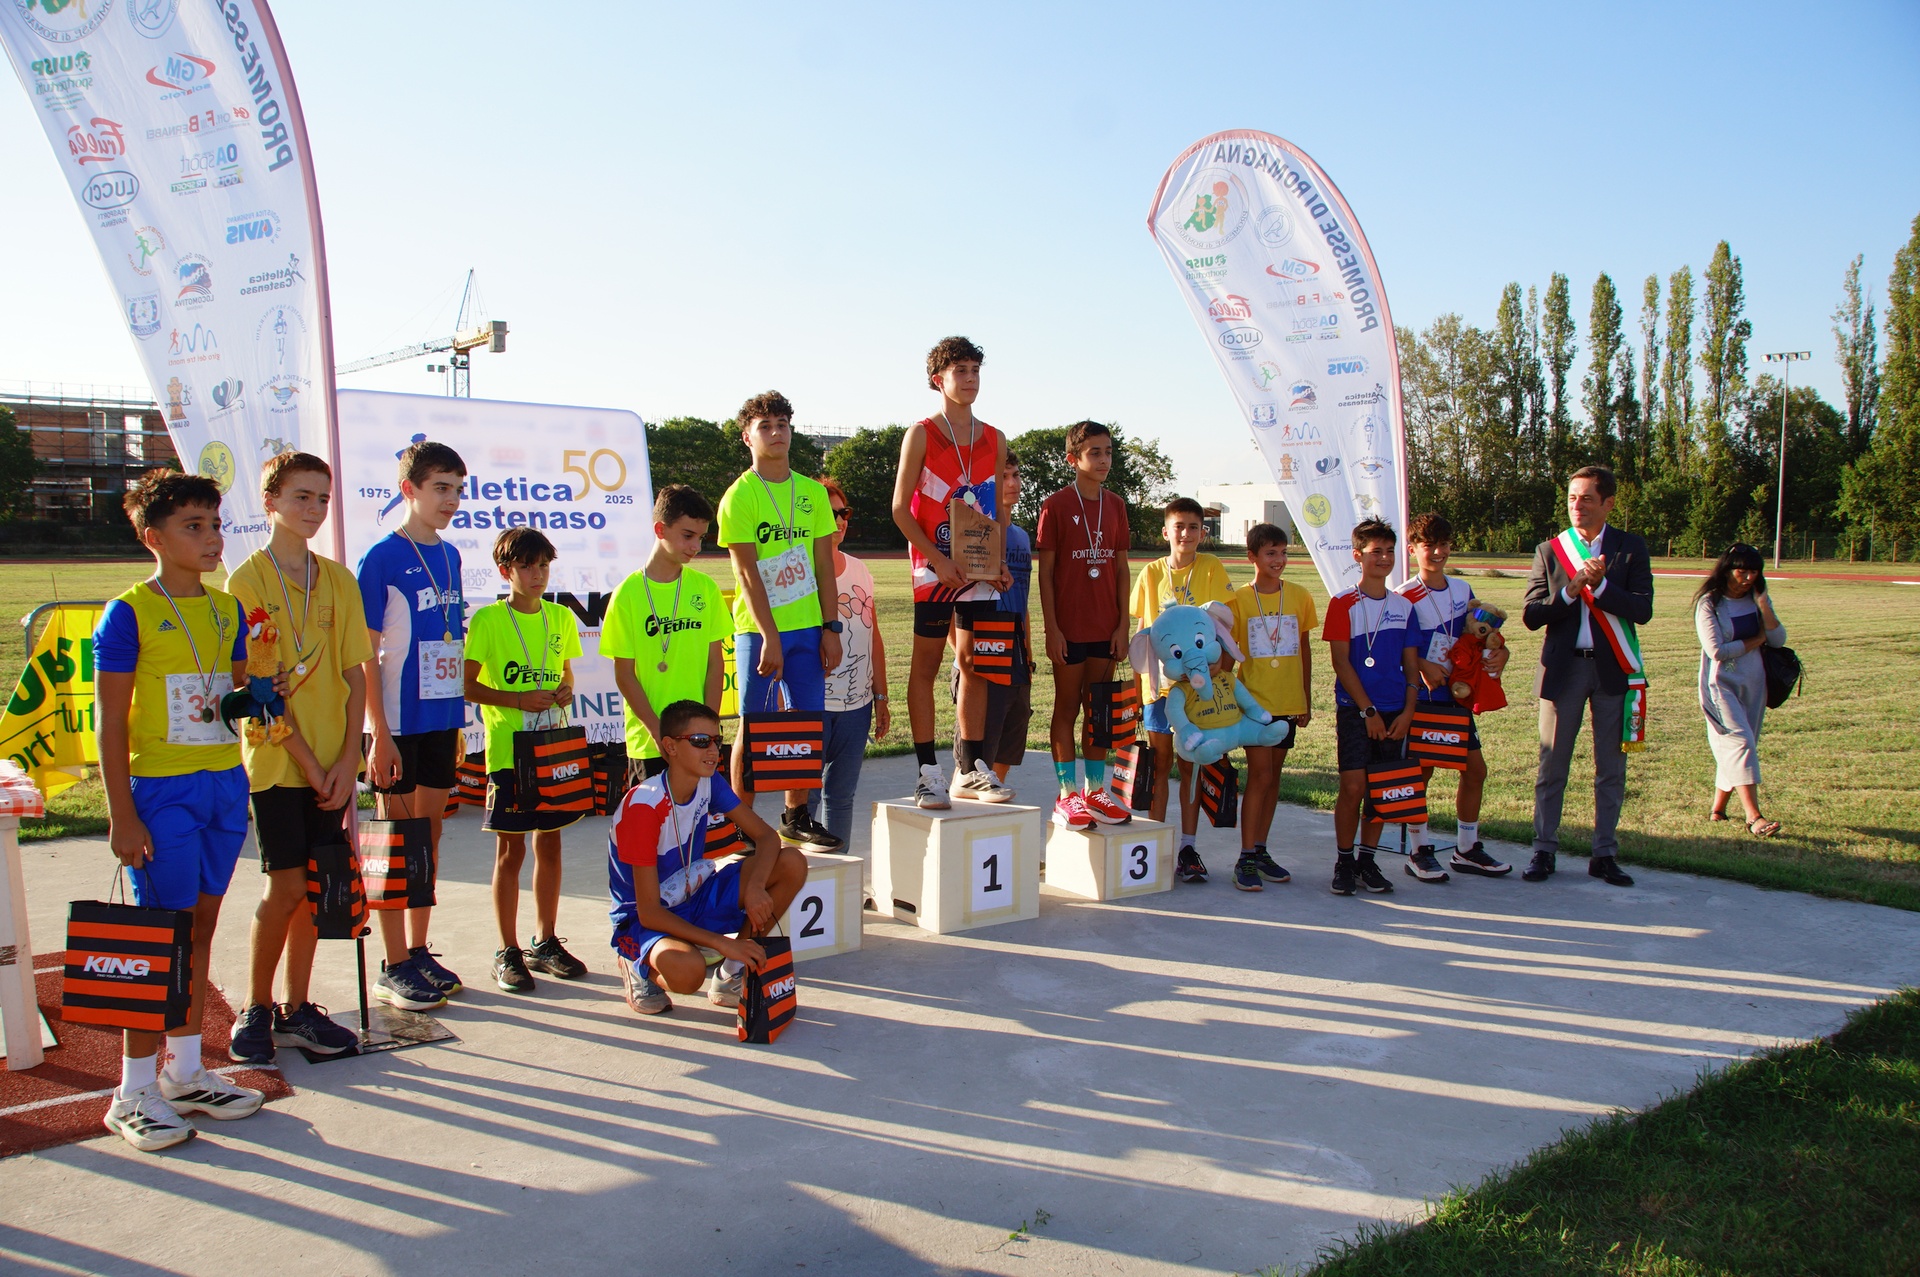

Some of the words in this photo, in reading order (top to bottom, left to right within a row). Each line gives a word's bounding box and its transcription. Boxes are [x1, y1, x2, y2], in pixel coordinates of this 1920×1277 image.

[563, 448, 627, 502] 50
[358, 487, 391, 499] 1975
[459, 475, 574, 502] tletica
[605, 495, 634, 505] 2025
[452, 505, 607, 530] astenaso
[773, 528, 811, 541] Ethic
[775, 562, 806, 589] 499
[663, 619, 703, 635] Ethics
[973, 641, 1006, 653] KING
[435, 657, 462, 681] 551
[521, 670, 561, 684] Ethics
[1421, 730, 1461, 744] KING
[766, 743, 812, 757] KING
[552, 763, 579, 781] KING
[1113, 765, 1131, 780] KING
[461, 775, 480, 787] KING
[1382, 785, 1415, 801] KING
[363, 857, 390, 873] KING
[1129, 844, 1149, 880] 3
[982, 854, 1002, 893] 1
[800, 896, 825, 939] 2
[83, 955, 151, 977] KING
[768, 977, 796, 994] KING
